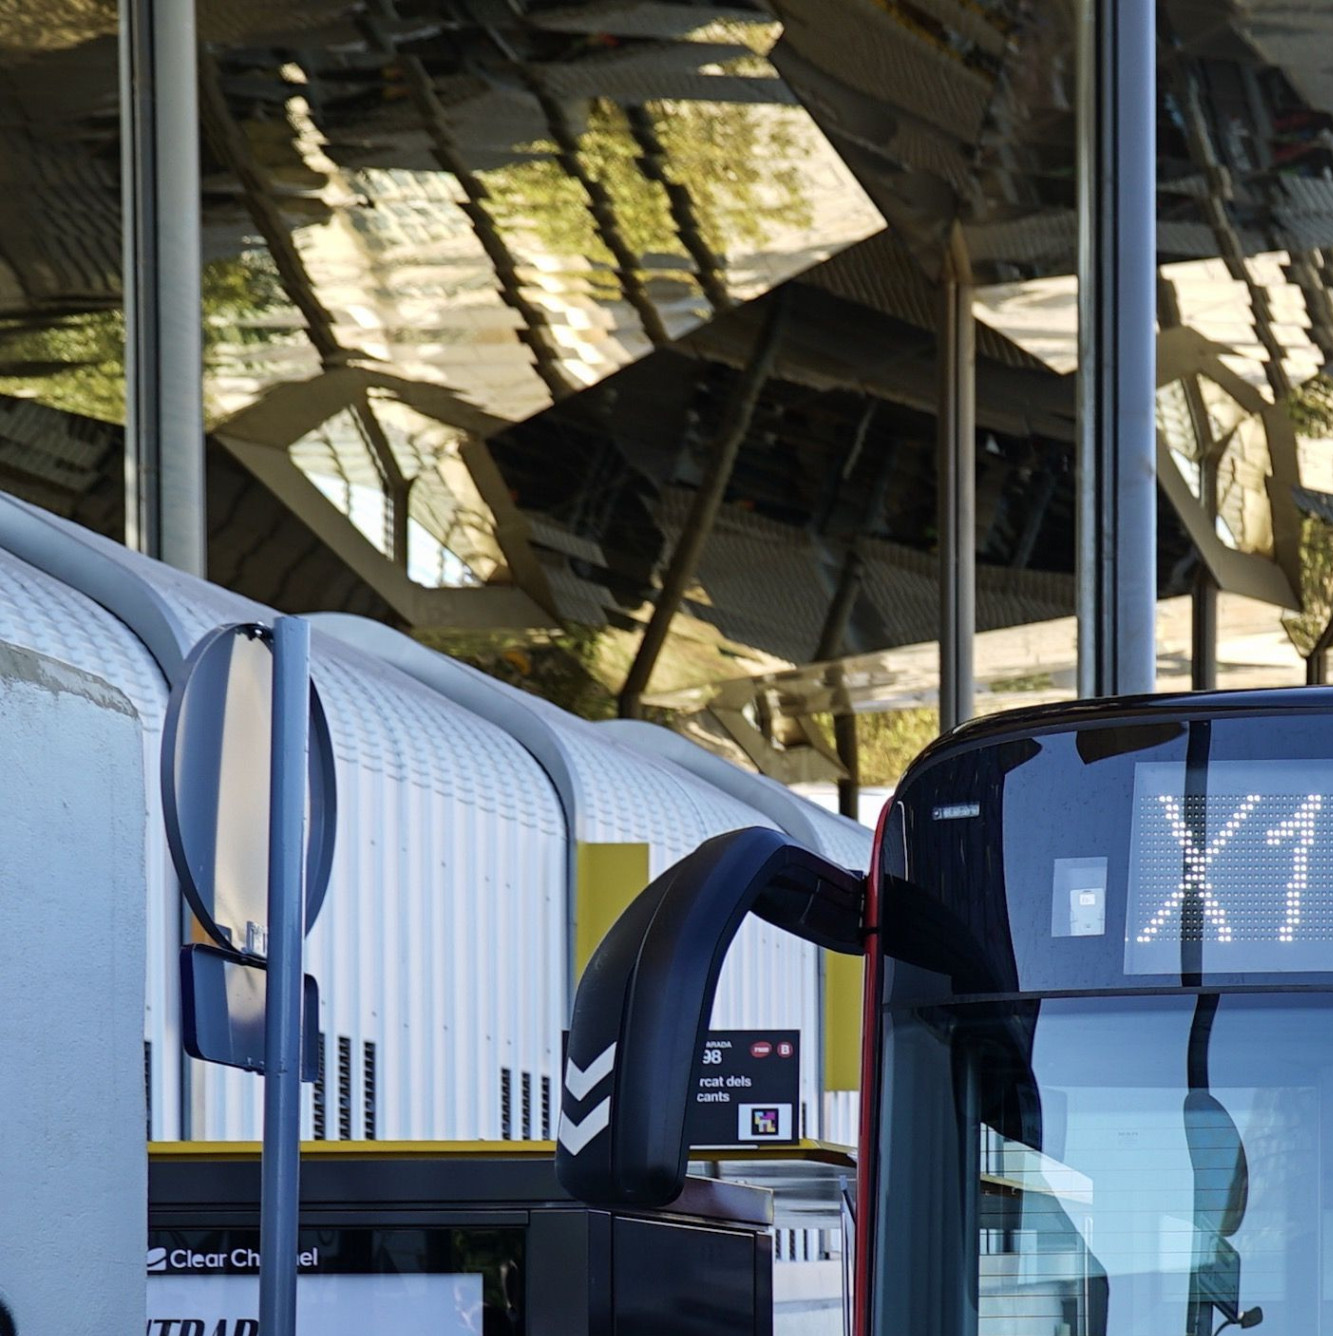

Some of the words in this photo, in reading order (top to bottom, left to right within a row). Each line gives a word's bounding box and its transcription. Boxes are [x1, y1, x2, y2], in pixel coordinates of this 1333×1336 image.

[1136, 794, 1322, 943] X1
[781, 1044, 790, 1055] B
[726, 1075, 752, 1088] dels
[170, 1249, 227, 1268] Clear
